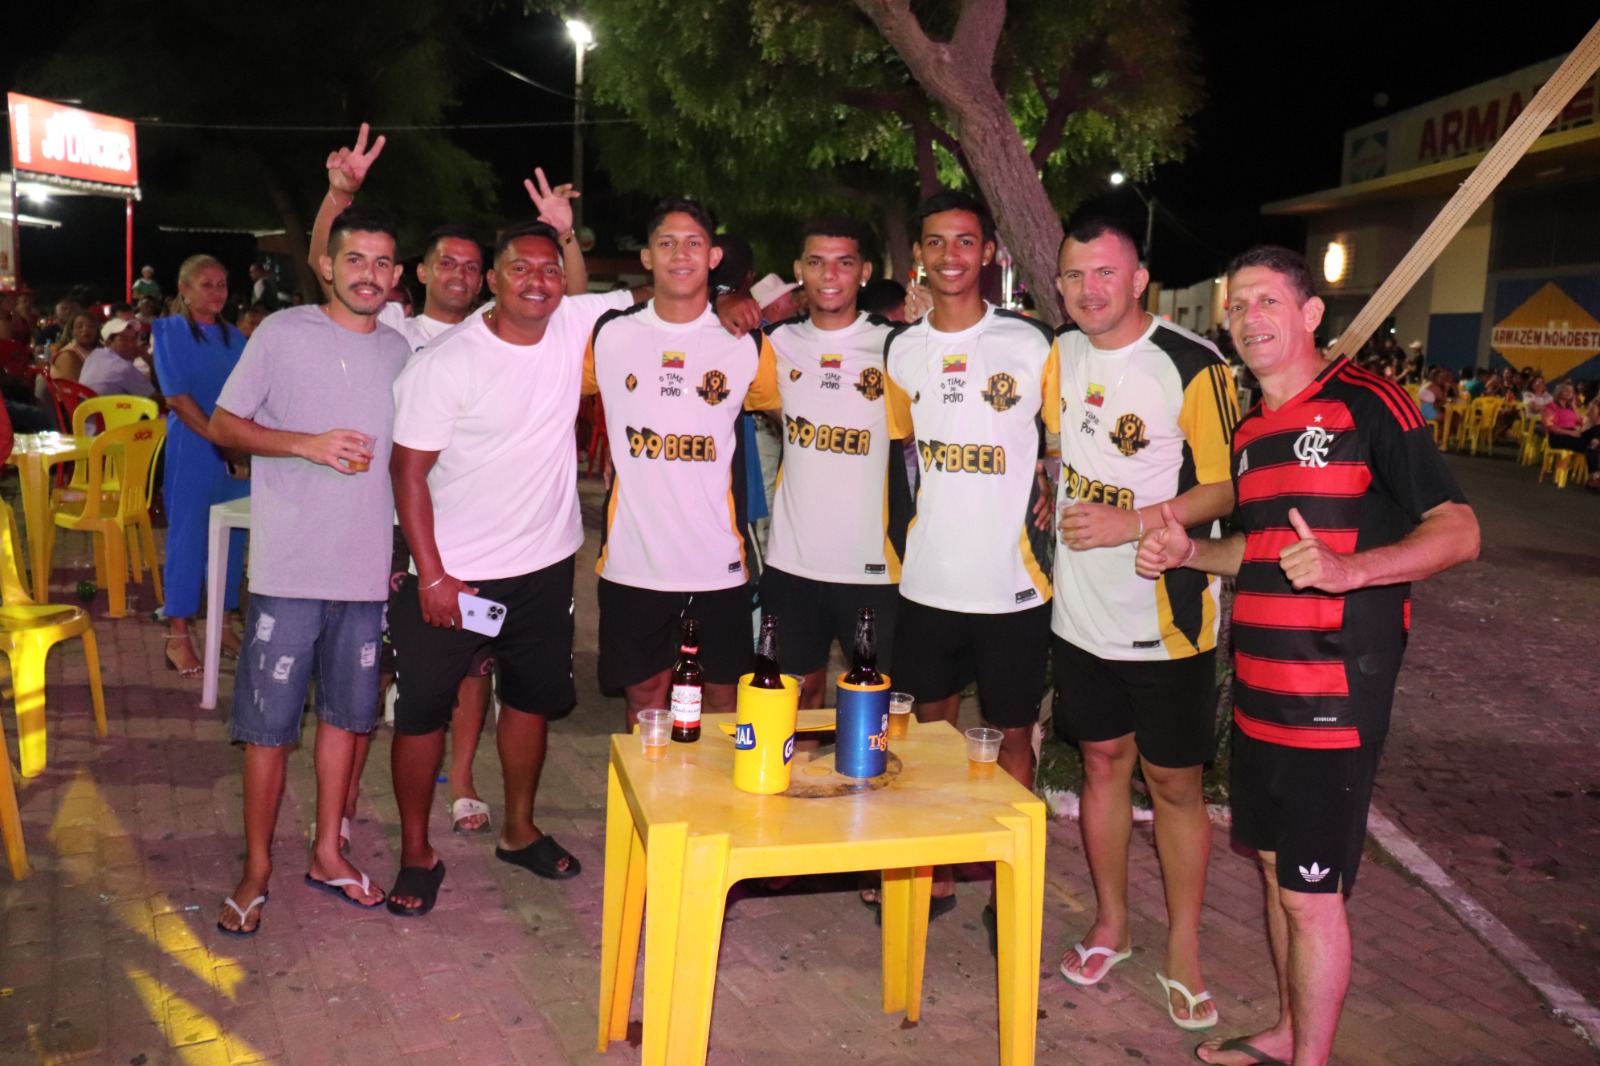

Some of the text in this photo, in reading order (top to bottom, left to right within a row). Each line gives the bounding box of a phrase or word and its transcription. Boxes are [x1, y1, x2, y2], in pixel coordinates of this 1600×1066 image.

[1544, 330, 1600, 347] NORDEST
[666, 373, 684, 384] TIME
[947, 377, 966, 388] TIME
[661, 386, 681, 397] POVO
